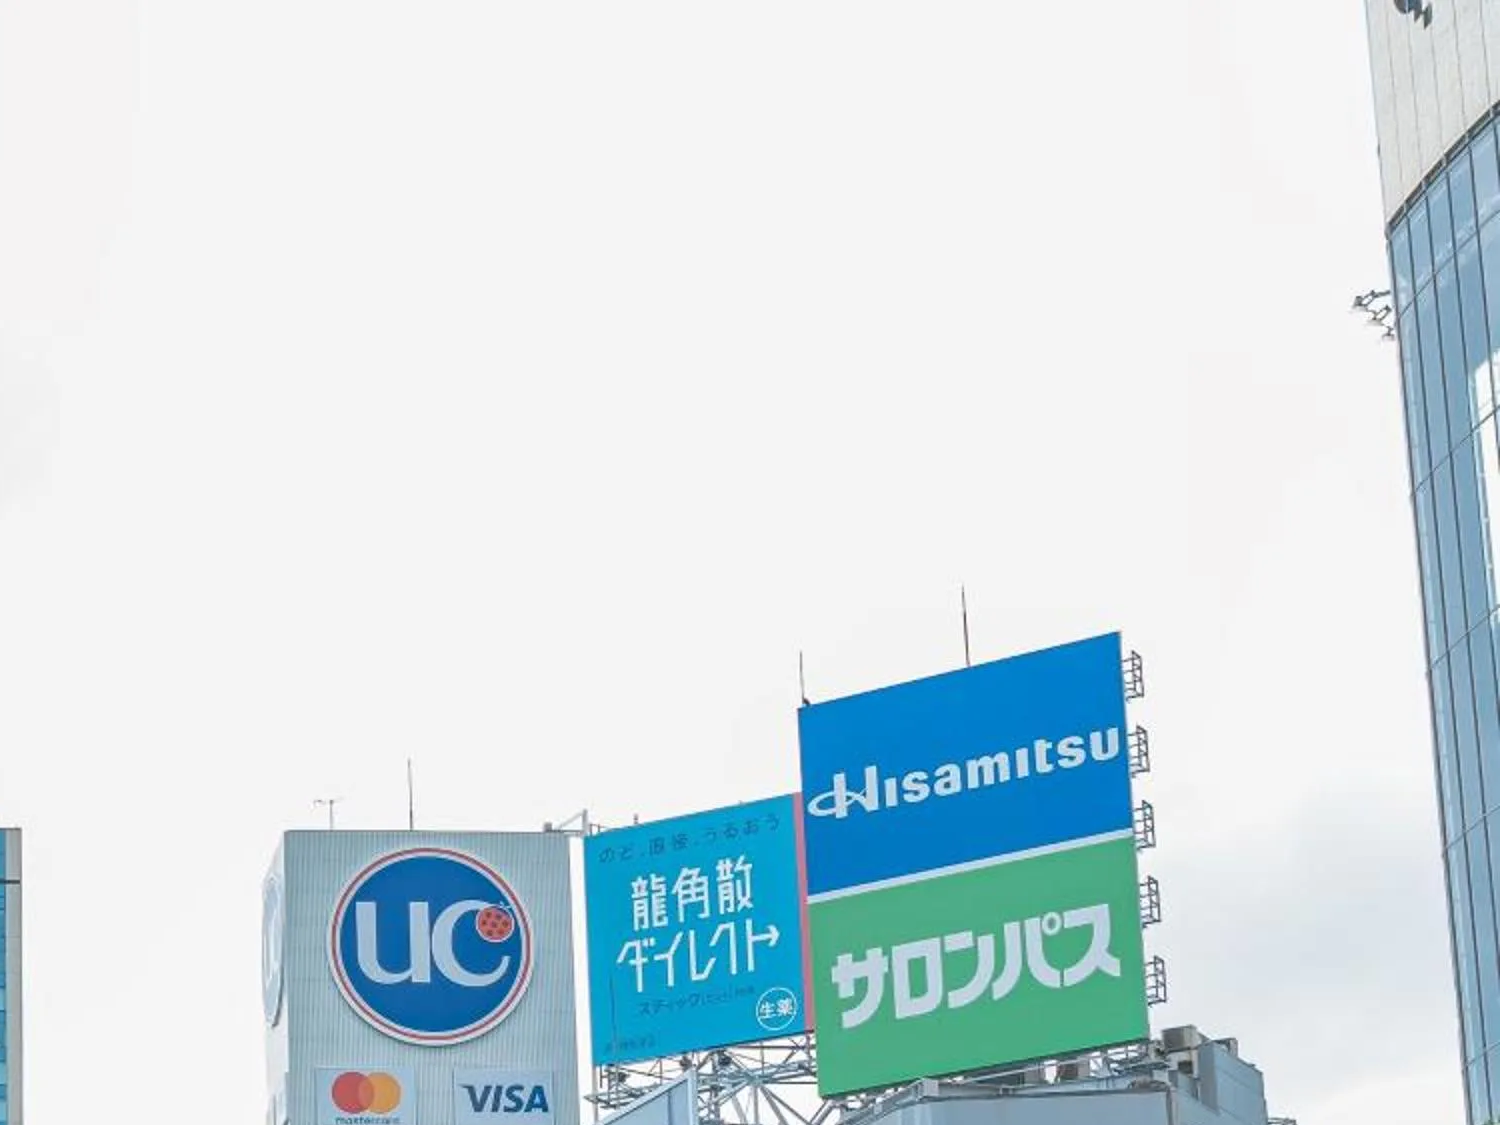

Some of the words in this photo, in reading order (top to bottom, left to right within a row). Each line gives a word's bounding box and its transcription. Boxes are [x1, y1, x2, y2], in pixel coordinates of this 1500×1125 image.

[807, 727, 1119, 819] Hisamitsu
[631, 855, 753, 931] 龍角散
[616, 919, 780, 993] ダイレクト
[831, 904, 1122, 1029] サロンパス
[758, 998, 794, 1020] 生薬
[460, 1085, 549, 1113] VISA
